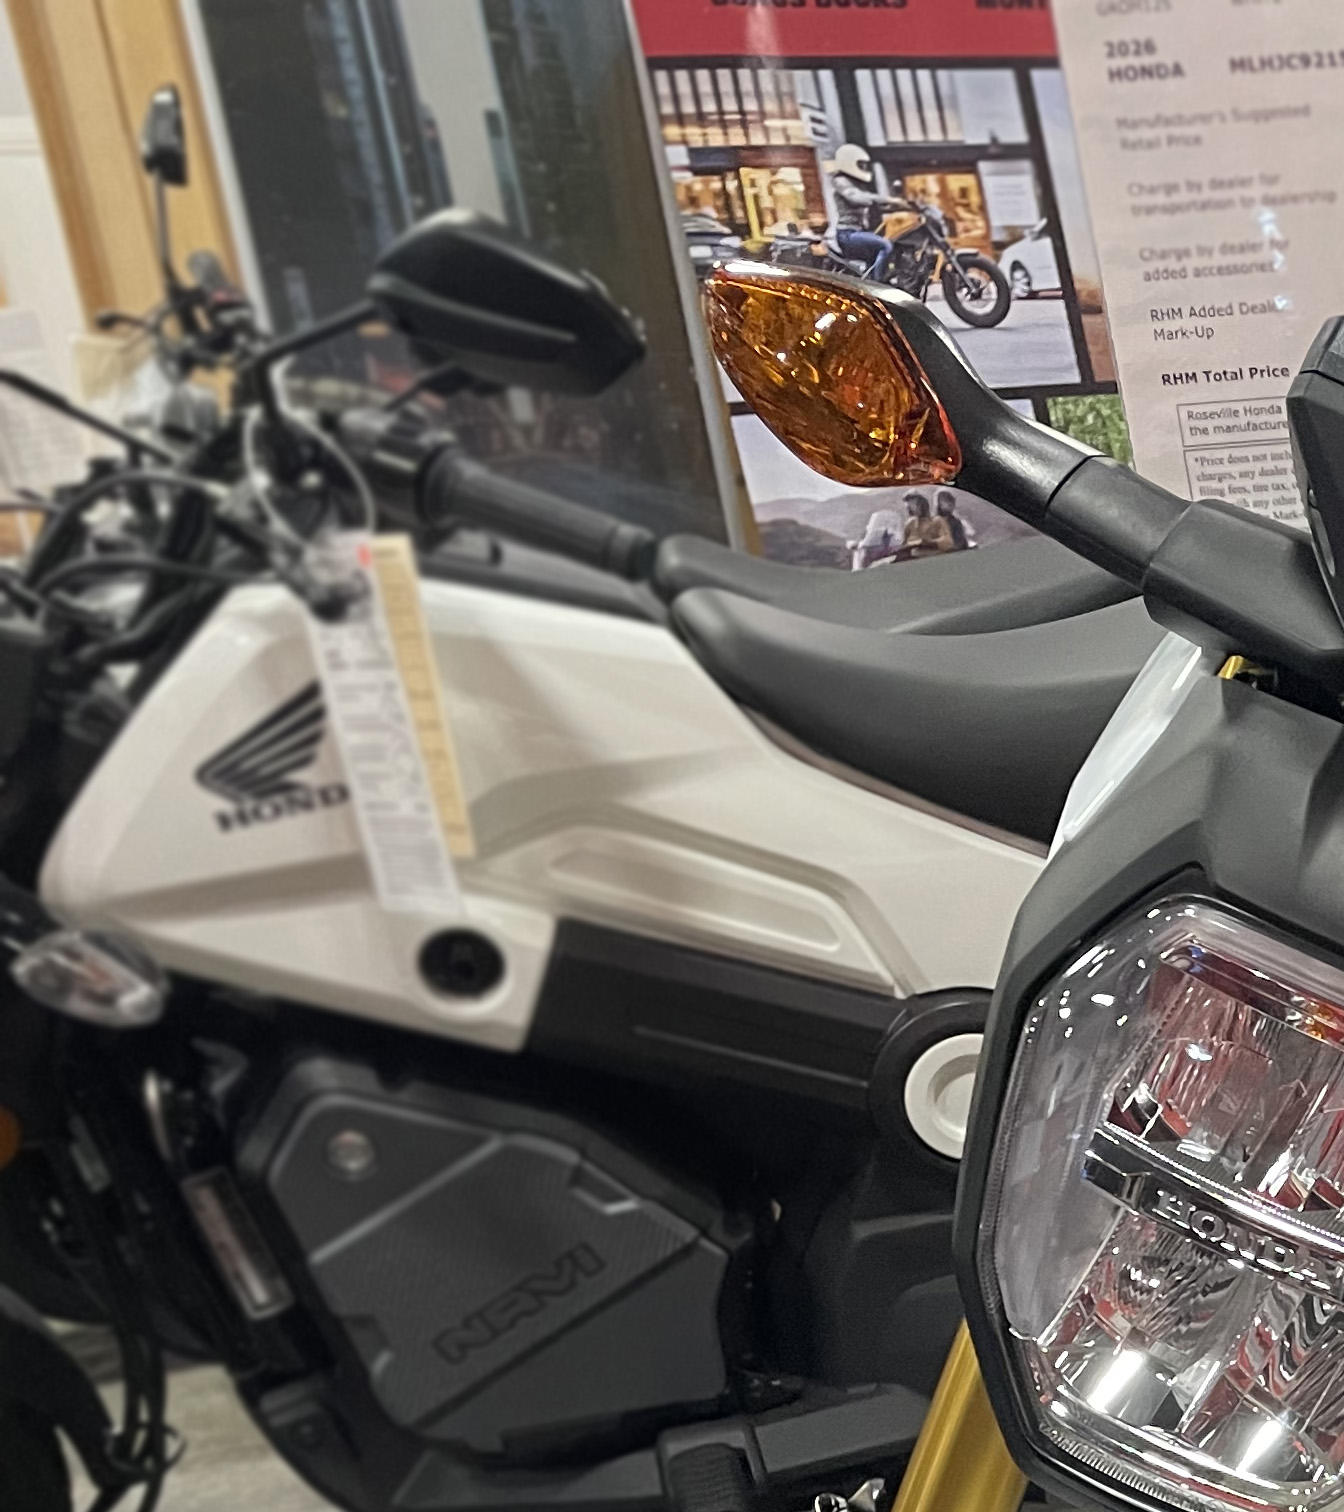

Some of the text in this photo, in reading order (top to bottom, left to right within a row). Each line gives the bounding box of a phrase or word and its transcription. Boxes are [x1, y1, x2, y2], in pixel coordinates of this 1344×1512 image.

[1104, 38, 1158, 60] 2026
[1107, 61, 1187, 84] HONDA
[1230, 103, 1312, 124] Suggested
[1166, 132, 1204, 148] Price
[1127, 179, 1182, 199] Charge
[1208, 172, 1255, 191] dealer
[1138, 245, 1192, 265] Charge
[1218, 239, 1264, 257] dealer
[1143, 264, 1188, 282] added
[1150, 306, 1184, 322] RHM
[1188, 301, 1234, 319] Added
[1153, 325, 1215, 342] Mark-Up
[1161, 364, 1291, 387] RHM Total Price
[1186, 404, 1283, 421] Roseville Honda
[1189, 425, 1210, 437] the
[213, 782, 350, 832] HOND
[1151, 1189, 1333, 1292] HONDA
